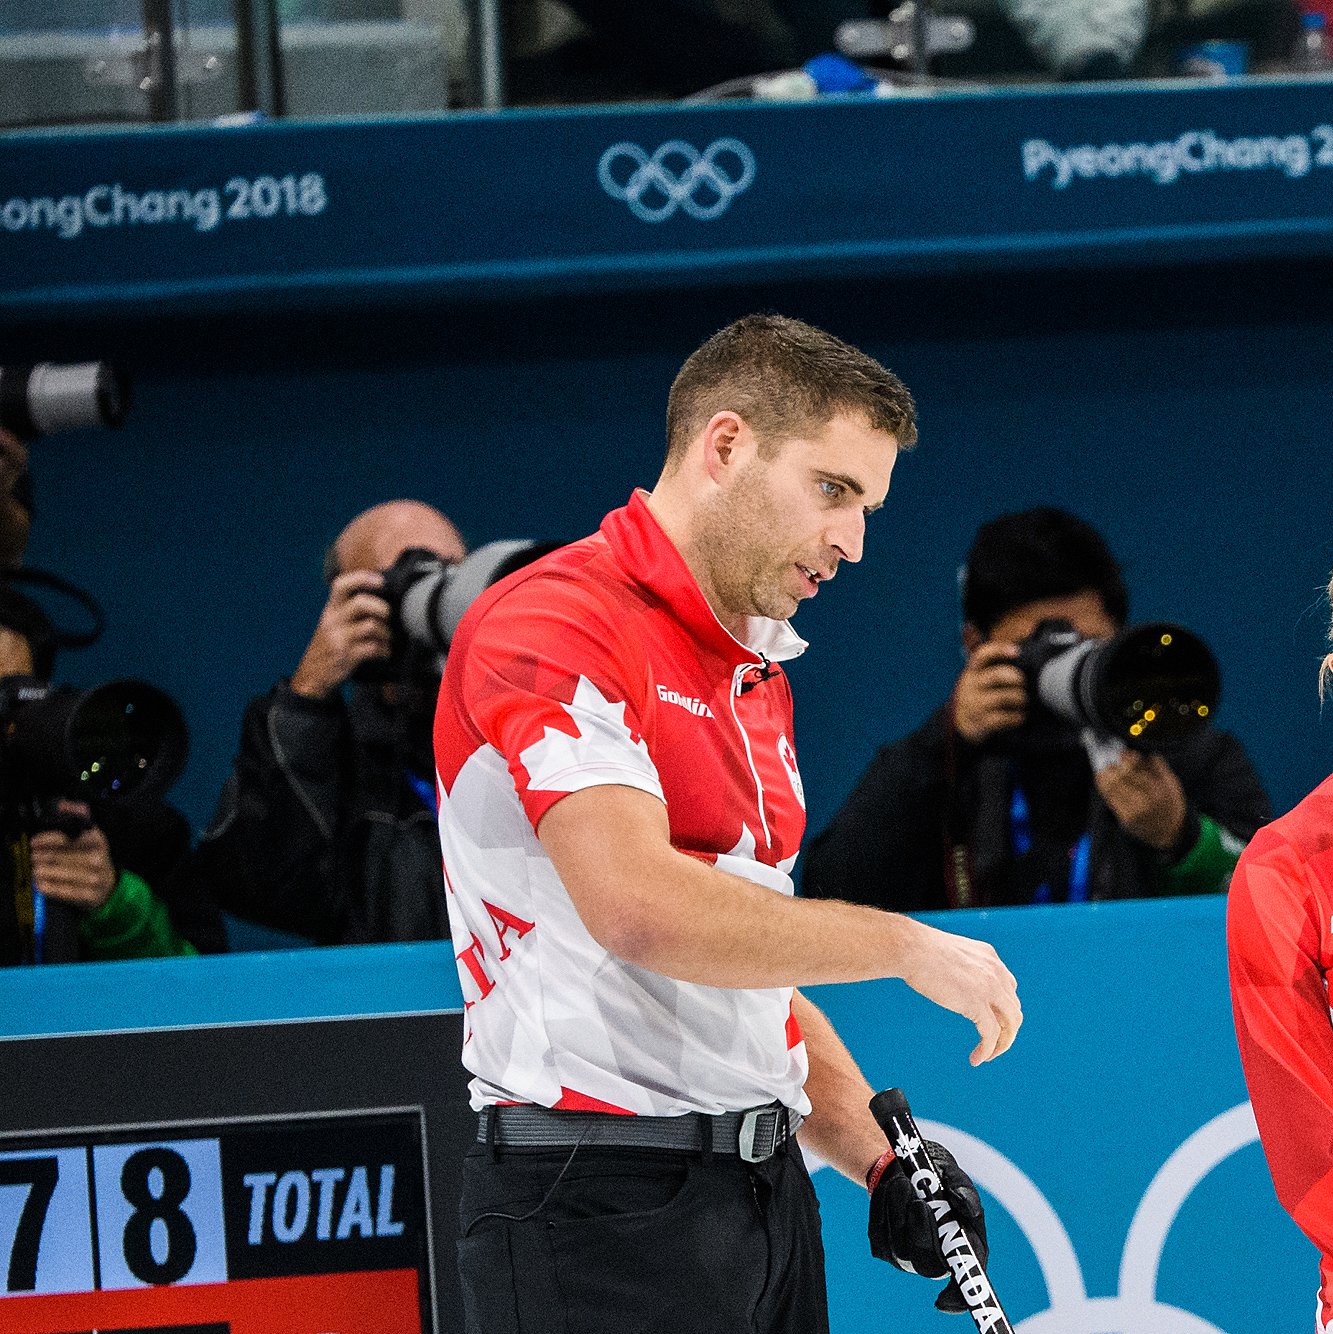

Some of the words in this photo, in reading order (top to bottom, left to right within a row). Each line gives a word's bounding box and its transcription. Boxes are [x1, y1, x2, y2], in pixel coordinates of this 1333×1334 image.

[223, 172, 328, 219] 2018
[1022, 129, 1311, 189] PyeongChang
[0, 1156, 60, 1293] 7
[120, 1147, 198, 1287] 8
[243, 1165, 406, 1247] TOTAL
